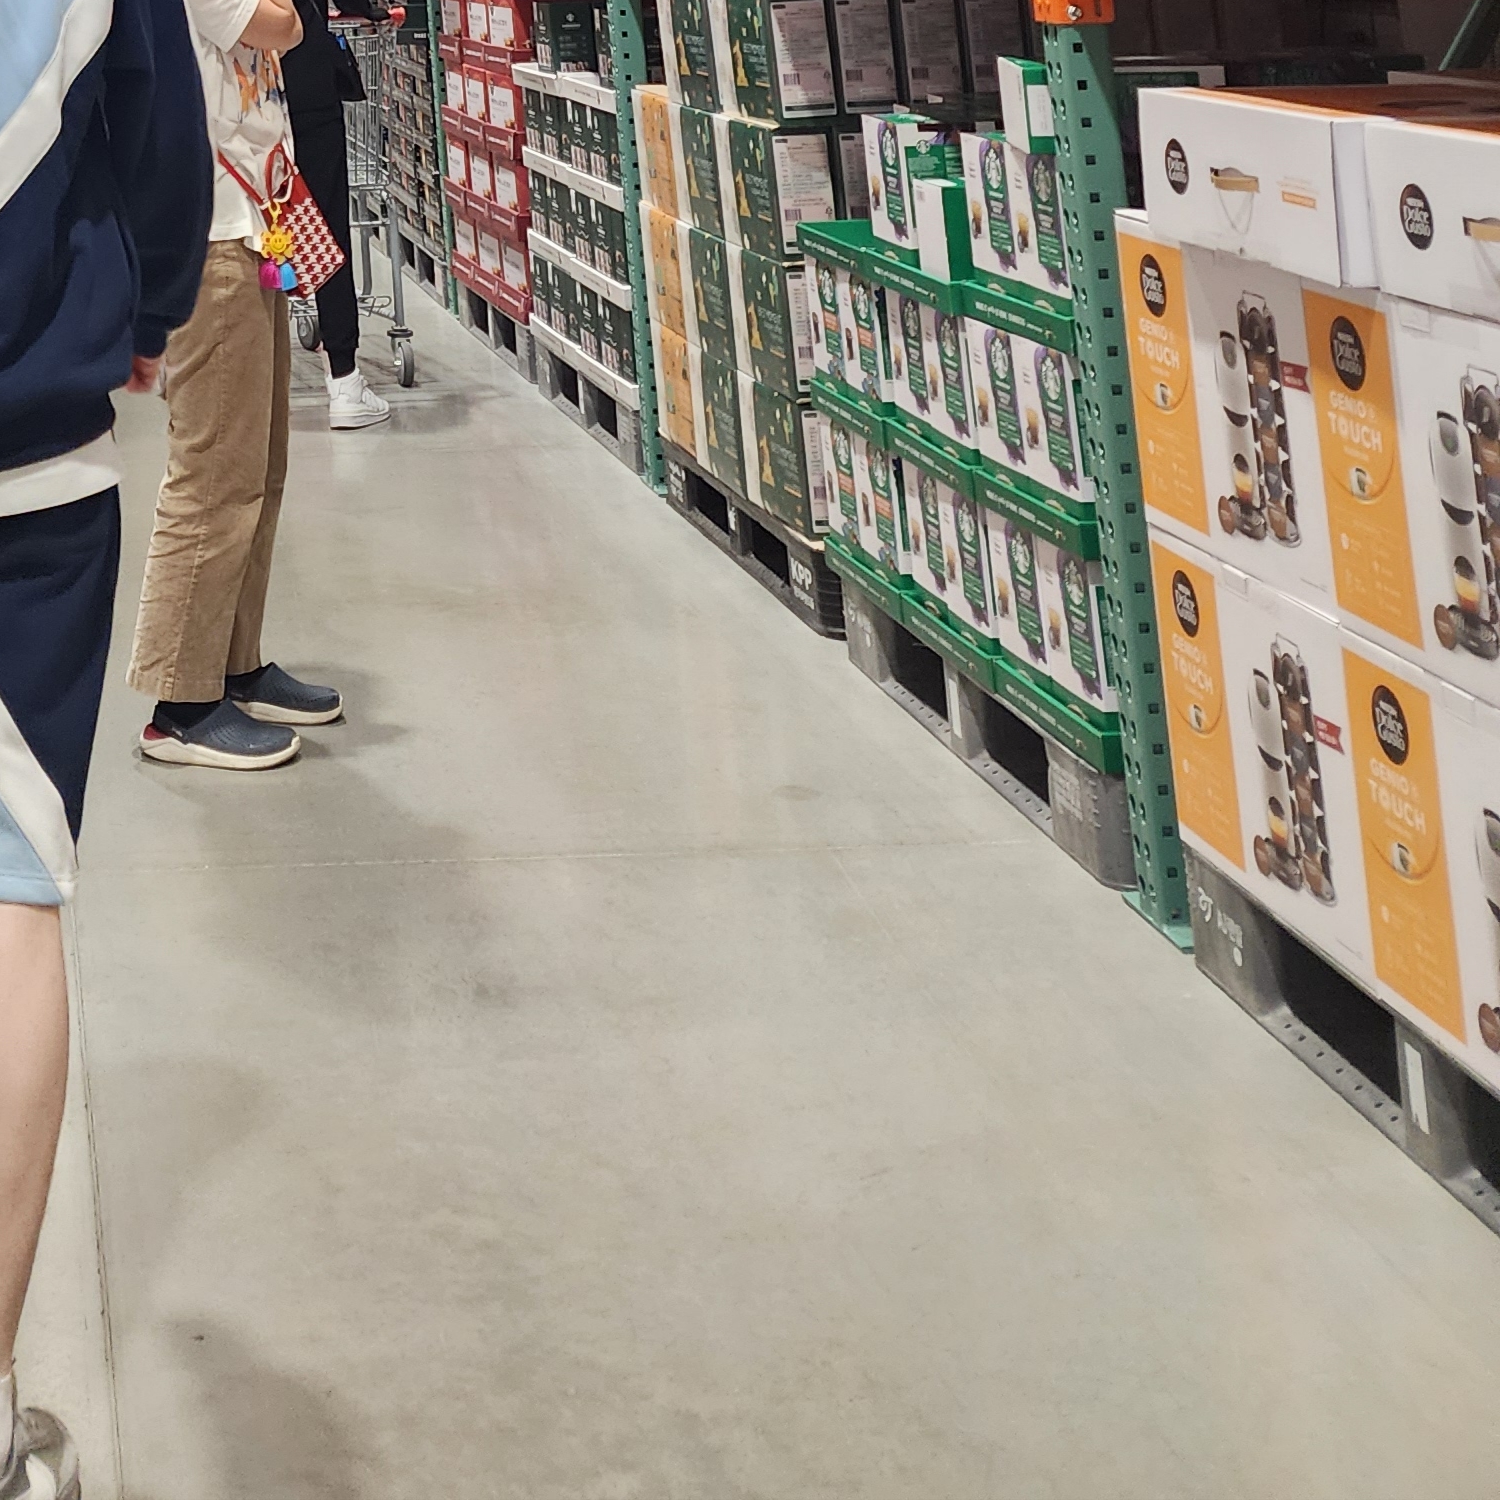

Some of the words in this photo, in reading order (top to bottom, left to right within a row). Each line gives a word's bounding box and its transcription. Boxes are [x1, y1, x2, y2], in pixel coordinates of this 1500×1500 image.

[1168, 157, 1186, 172] Dolce
[1403, 205, 1430, 224] Dolce
[1405, 219, 1431, 237] Gusto
[1142, 274, 1163, 293] Dolce
[1139, 318, 1167, 339] GENIO
[1137, 336, 1180, 370] TOUCH
[1333, 339, 1361, 361] Dolce
[1329, 389, 1367, 418] GENIO
[1327, 411, 1383, 452] TOUCH
[790, 557, 813, 591] KPP
[1171, 650, 1214, 696] TOUCH
[1369, 757, 1410, 796] GENIO
[1367, 778, 1427, 835] TOUCH
